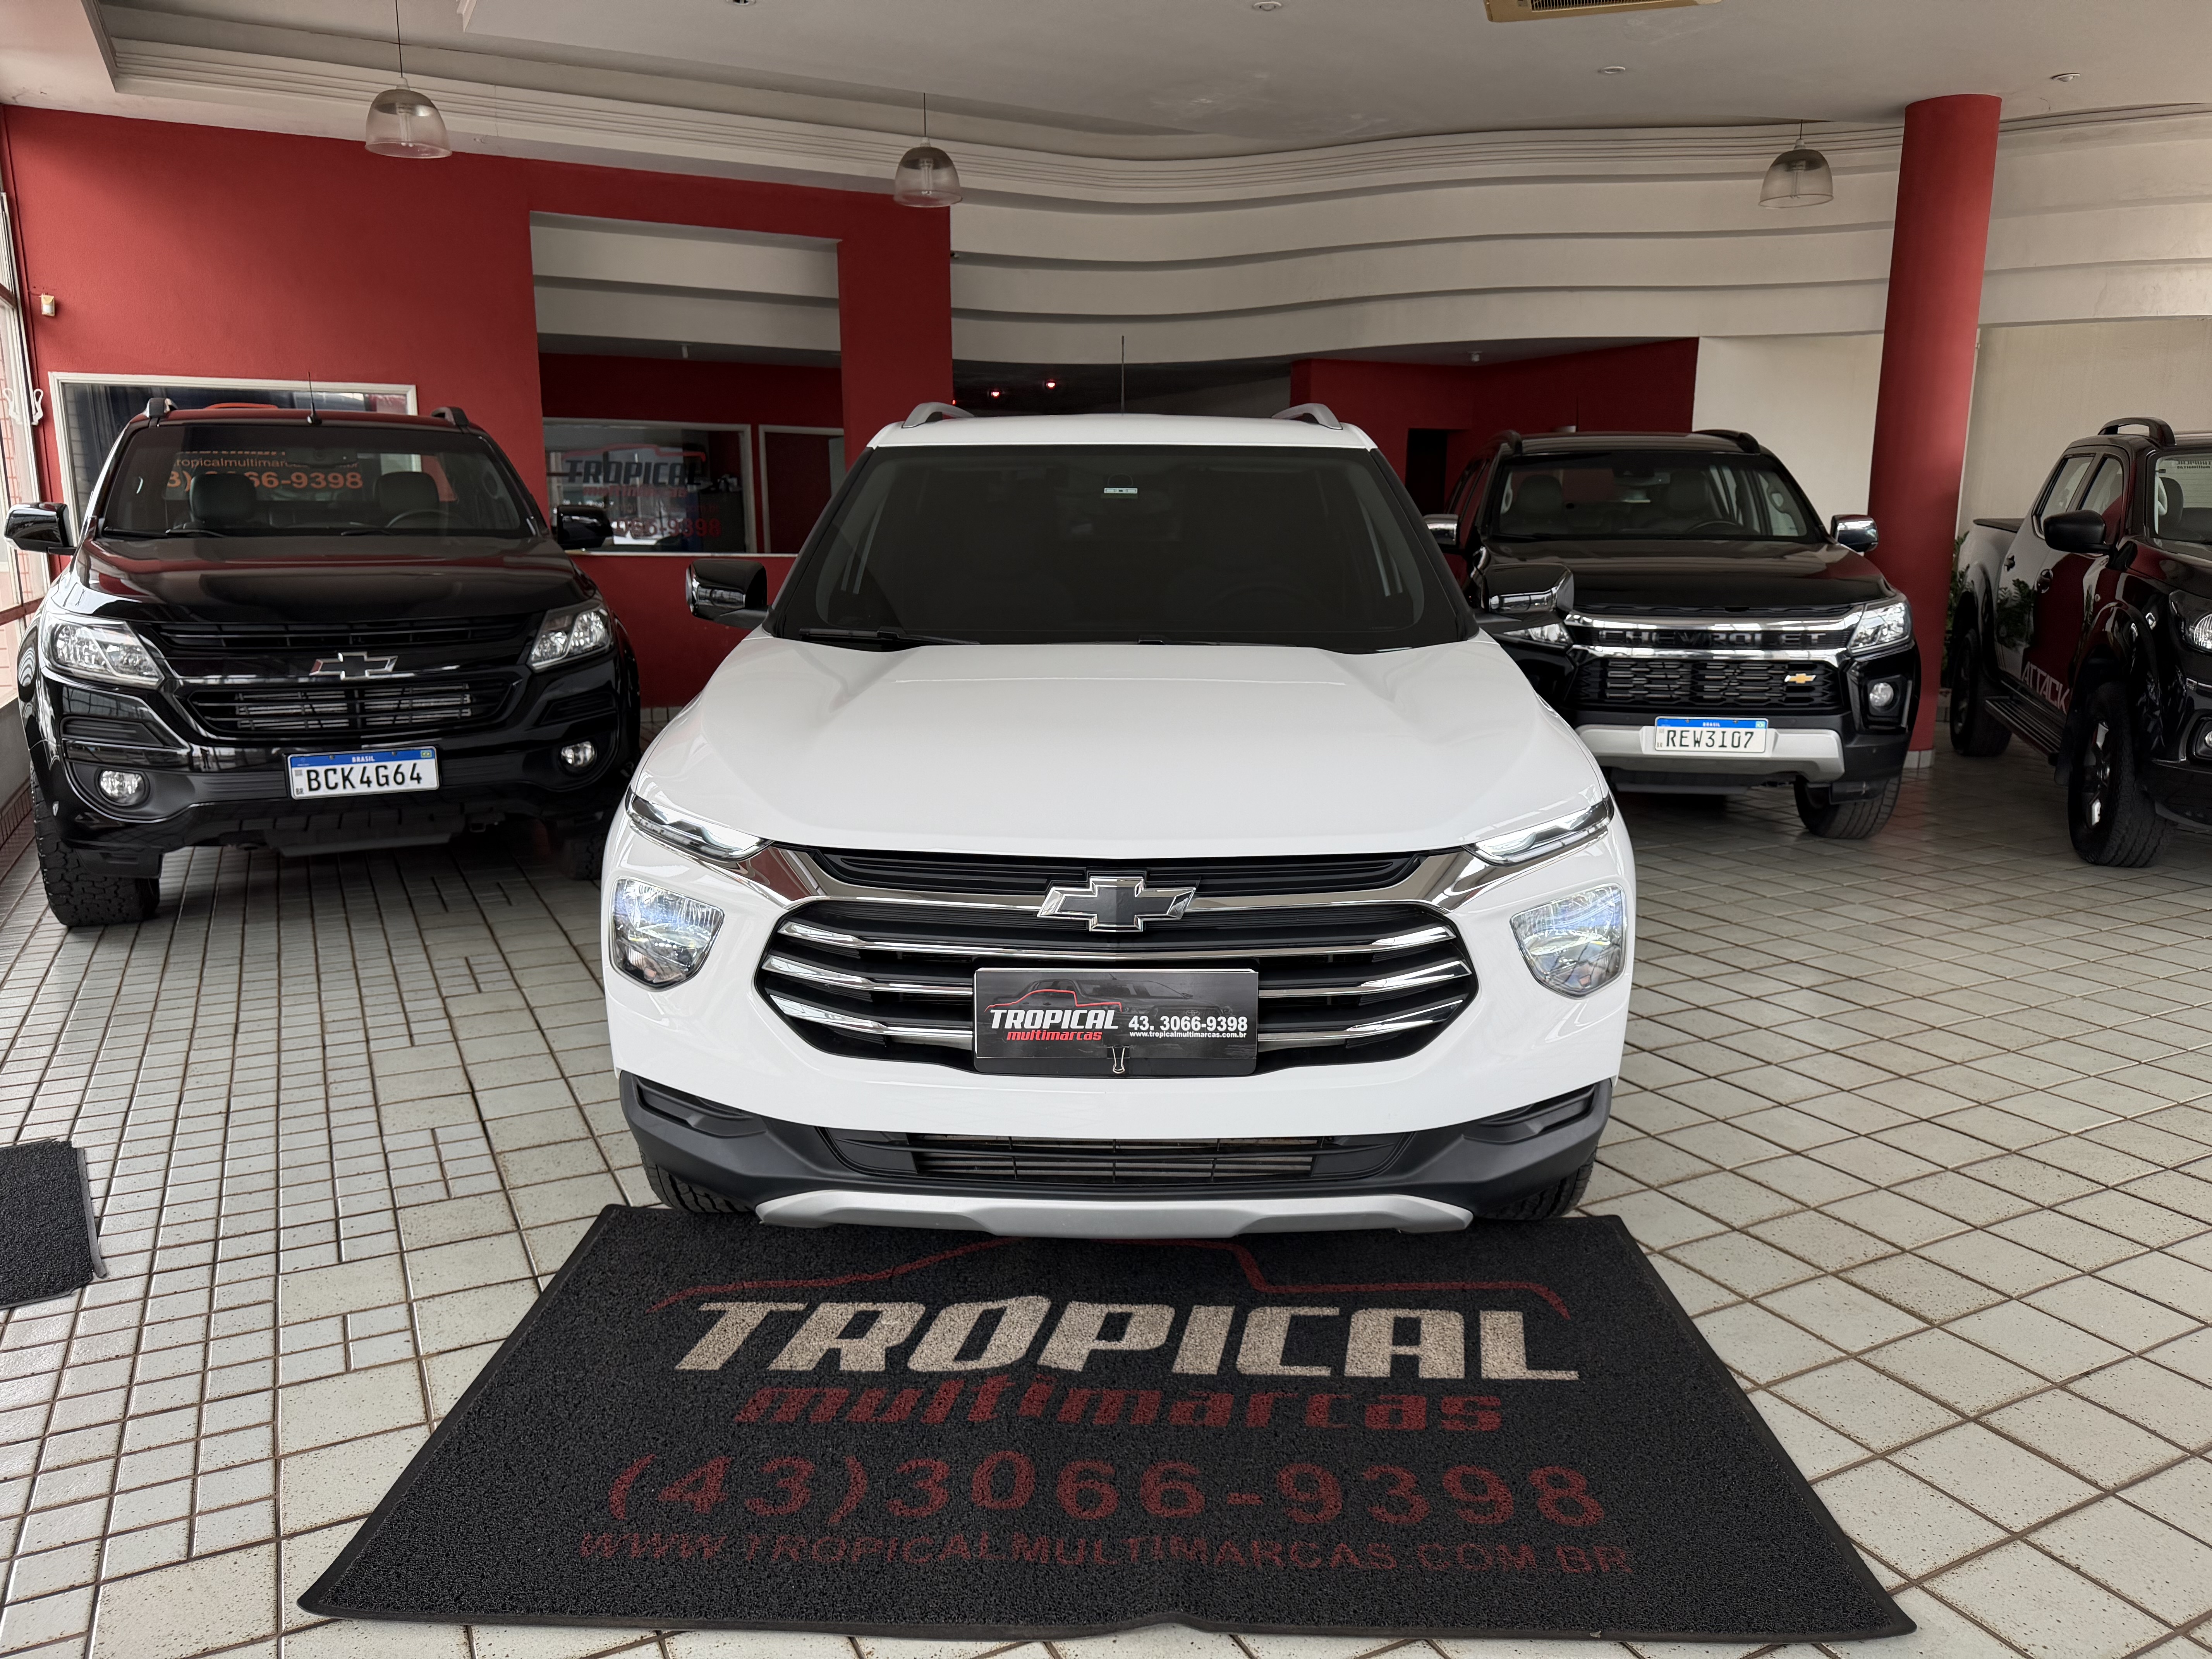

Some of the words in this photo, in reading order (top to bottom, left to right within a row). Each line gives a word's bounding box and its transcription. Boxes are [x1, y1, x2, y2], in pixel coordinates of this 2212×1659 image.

[566, 460, 701, 485] TROPICAL
[1599, 630, 1826, 646] CHEVROLET
[2021, 661, 2070, 715] ATTACK
[306, 763, 422, 792] BCK4G64
[990, 1010, 1118, 1029] TROPICAL
[1128, 1015, 1154, 1030] 43.
[1160, 1016, 1248, 1031] 3066-9398
[1007, 1030, 1103, 1041] multimarcas
[674, 1295, 1580, 1380] TROPICAL
[734, 1374, 1502, 1431] multimarcas
